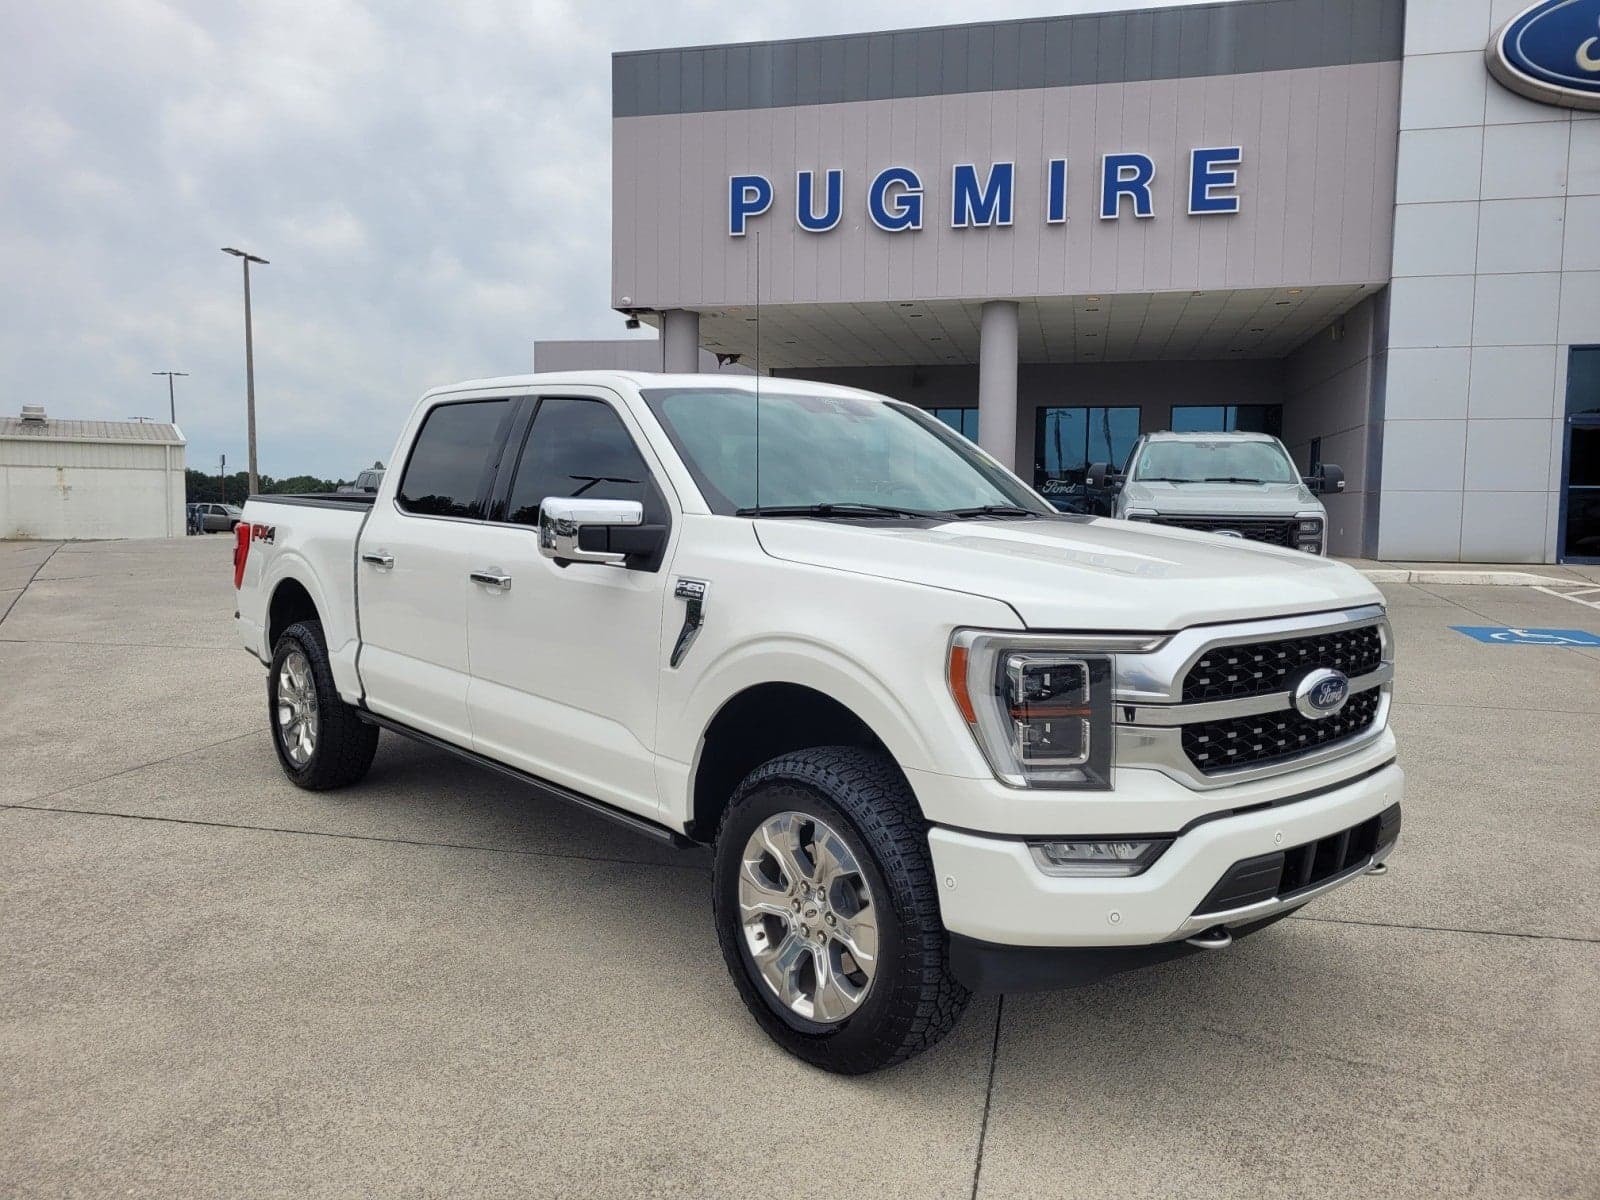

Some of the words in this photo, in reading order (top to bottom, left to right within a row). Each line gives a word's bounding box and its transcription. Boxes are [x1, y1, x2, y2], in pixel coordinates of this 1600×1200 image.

[728, 146, 1243, 237] PUGMIRE
[1042, 479, 1076, 493] Ford
[251, 524, 276, 542] FX4
[1318, 682, 1343, 704] Ford
